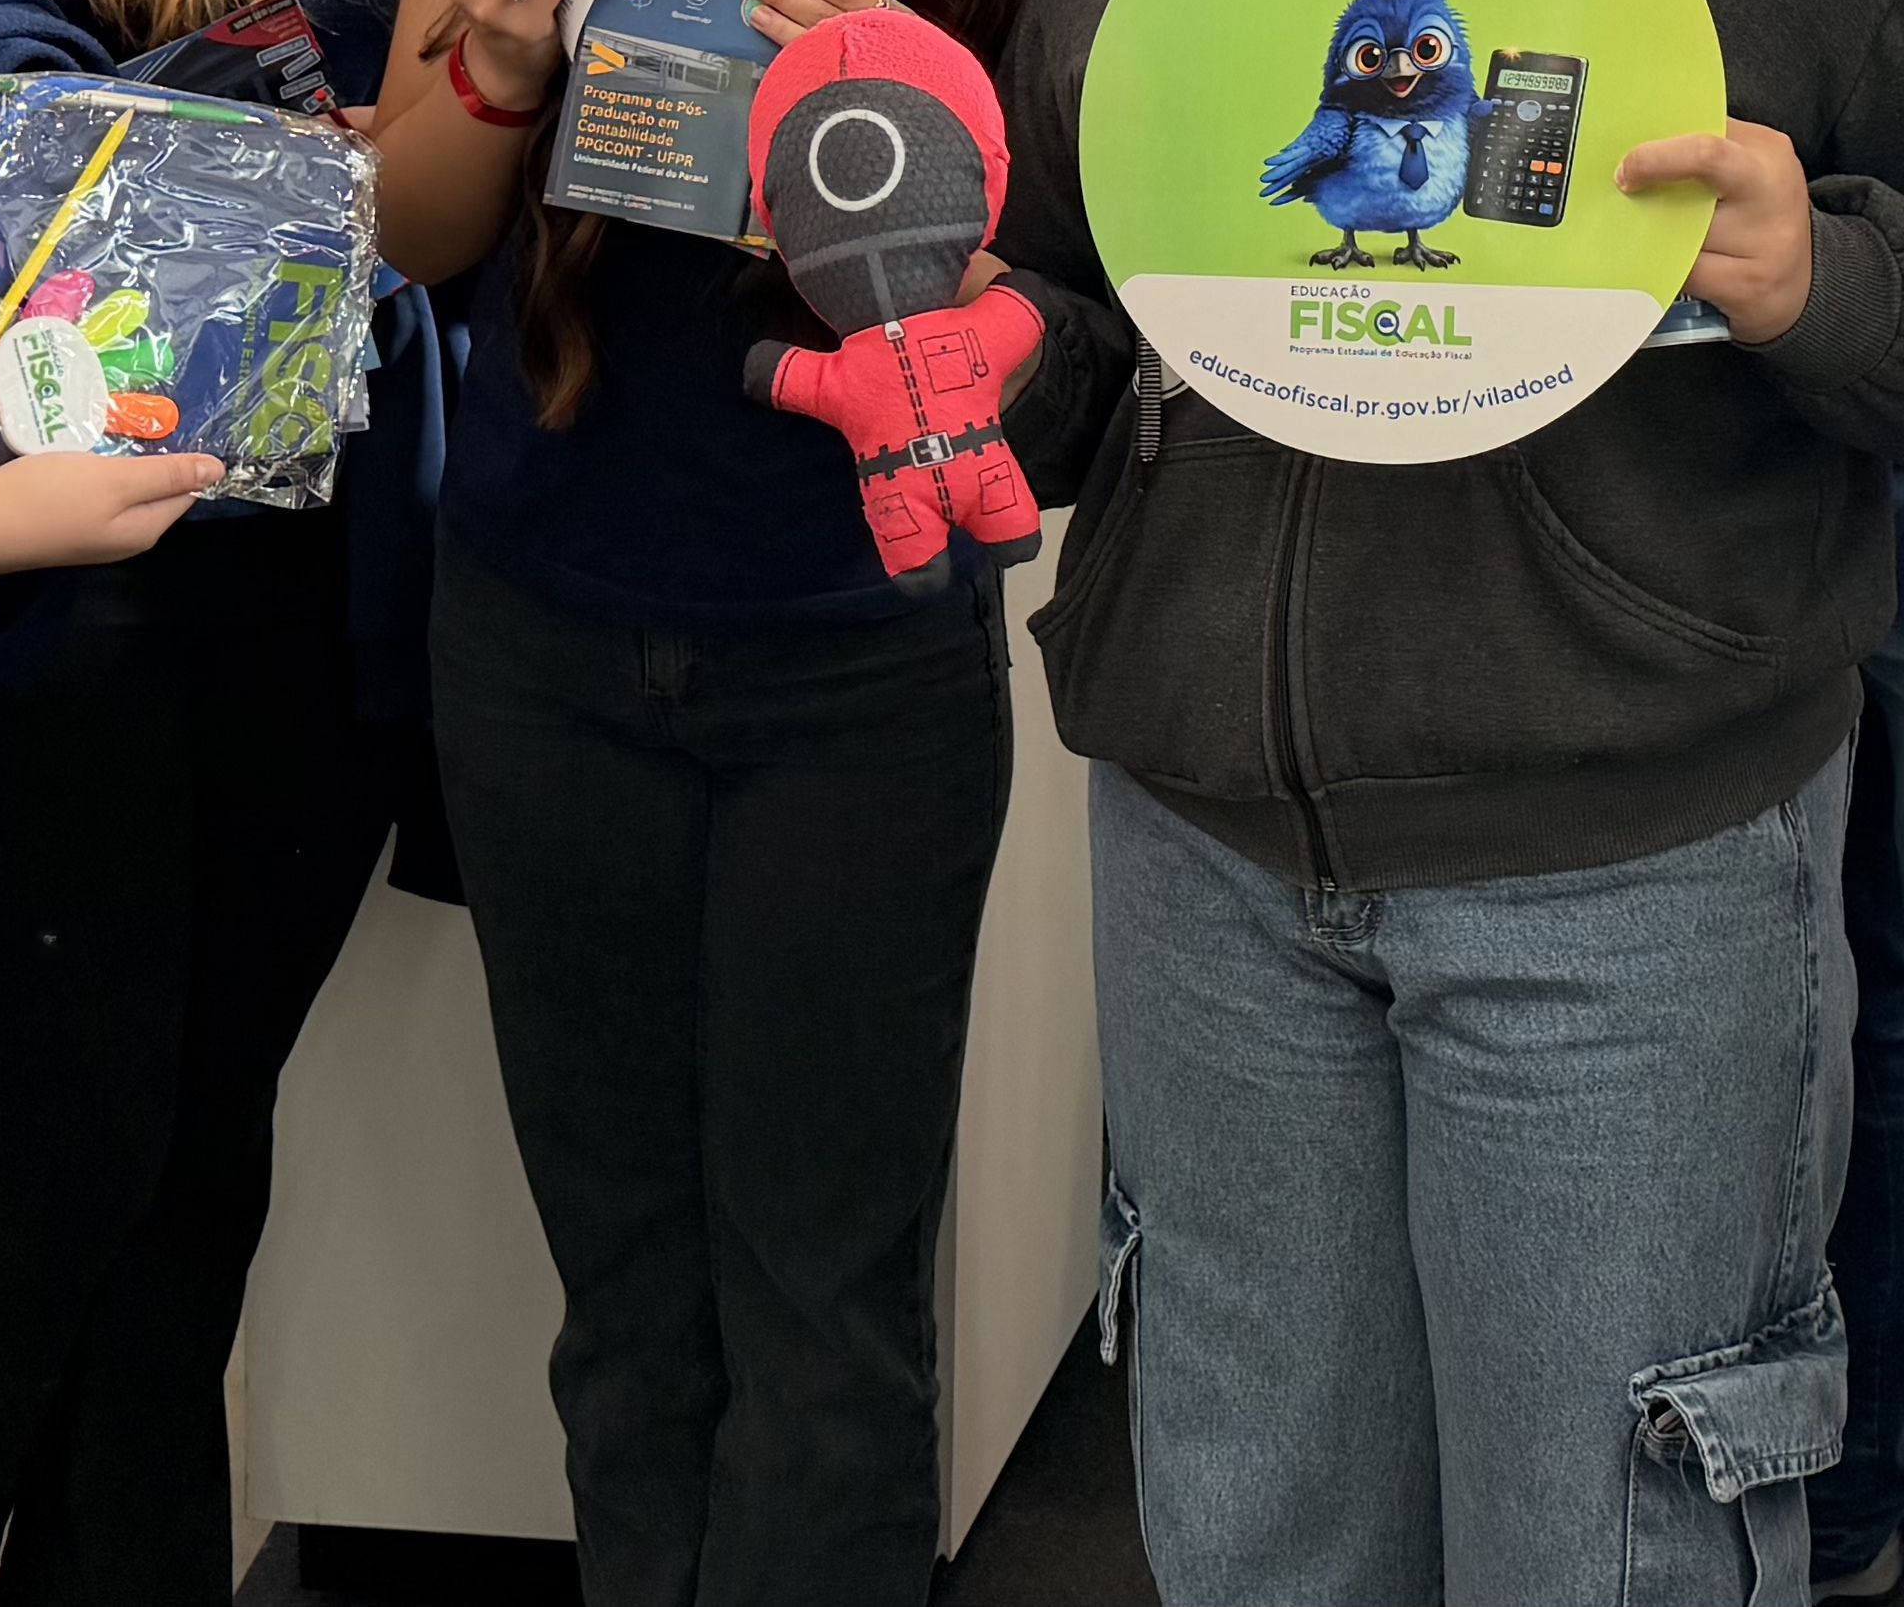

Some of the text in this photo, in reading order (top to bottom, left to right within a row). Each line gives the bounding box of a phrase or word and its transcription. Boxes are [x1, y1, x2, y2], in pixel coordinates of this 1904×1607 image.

[583, 84, 708, 117] Programa de Pós-
[580, 103, 680, 130] graduação em
[577, 118, 674, 147] Contabilidade
[575, 134, 644, 159] PPGCONT
[657, 149, 694, 168] UFPR
[1290, 284, 1371, 299] EDUCAÇÃO
[1290, 299, 1473, 347] FISCAL
[1289, 345, 1335, 356] Programa
[1445, 351, 1473, 361] Fiscal
[1188, 347, 1573, 420] educacaofiscal.pr.gov.br/viladoed
